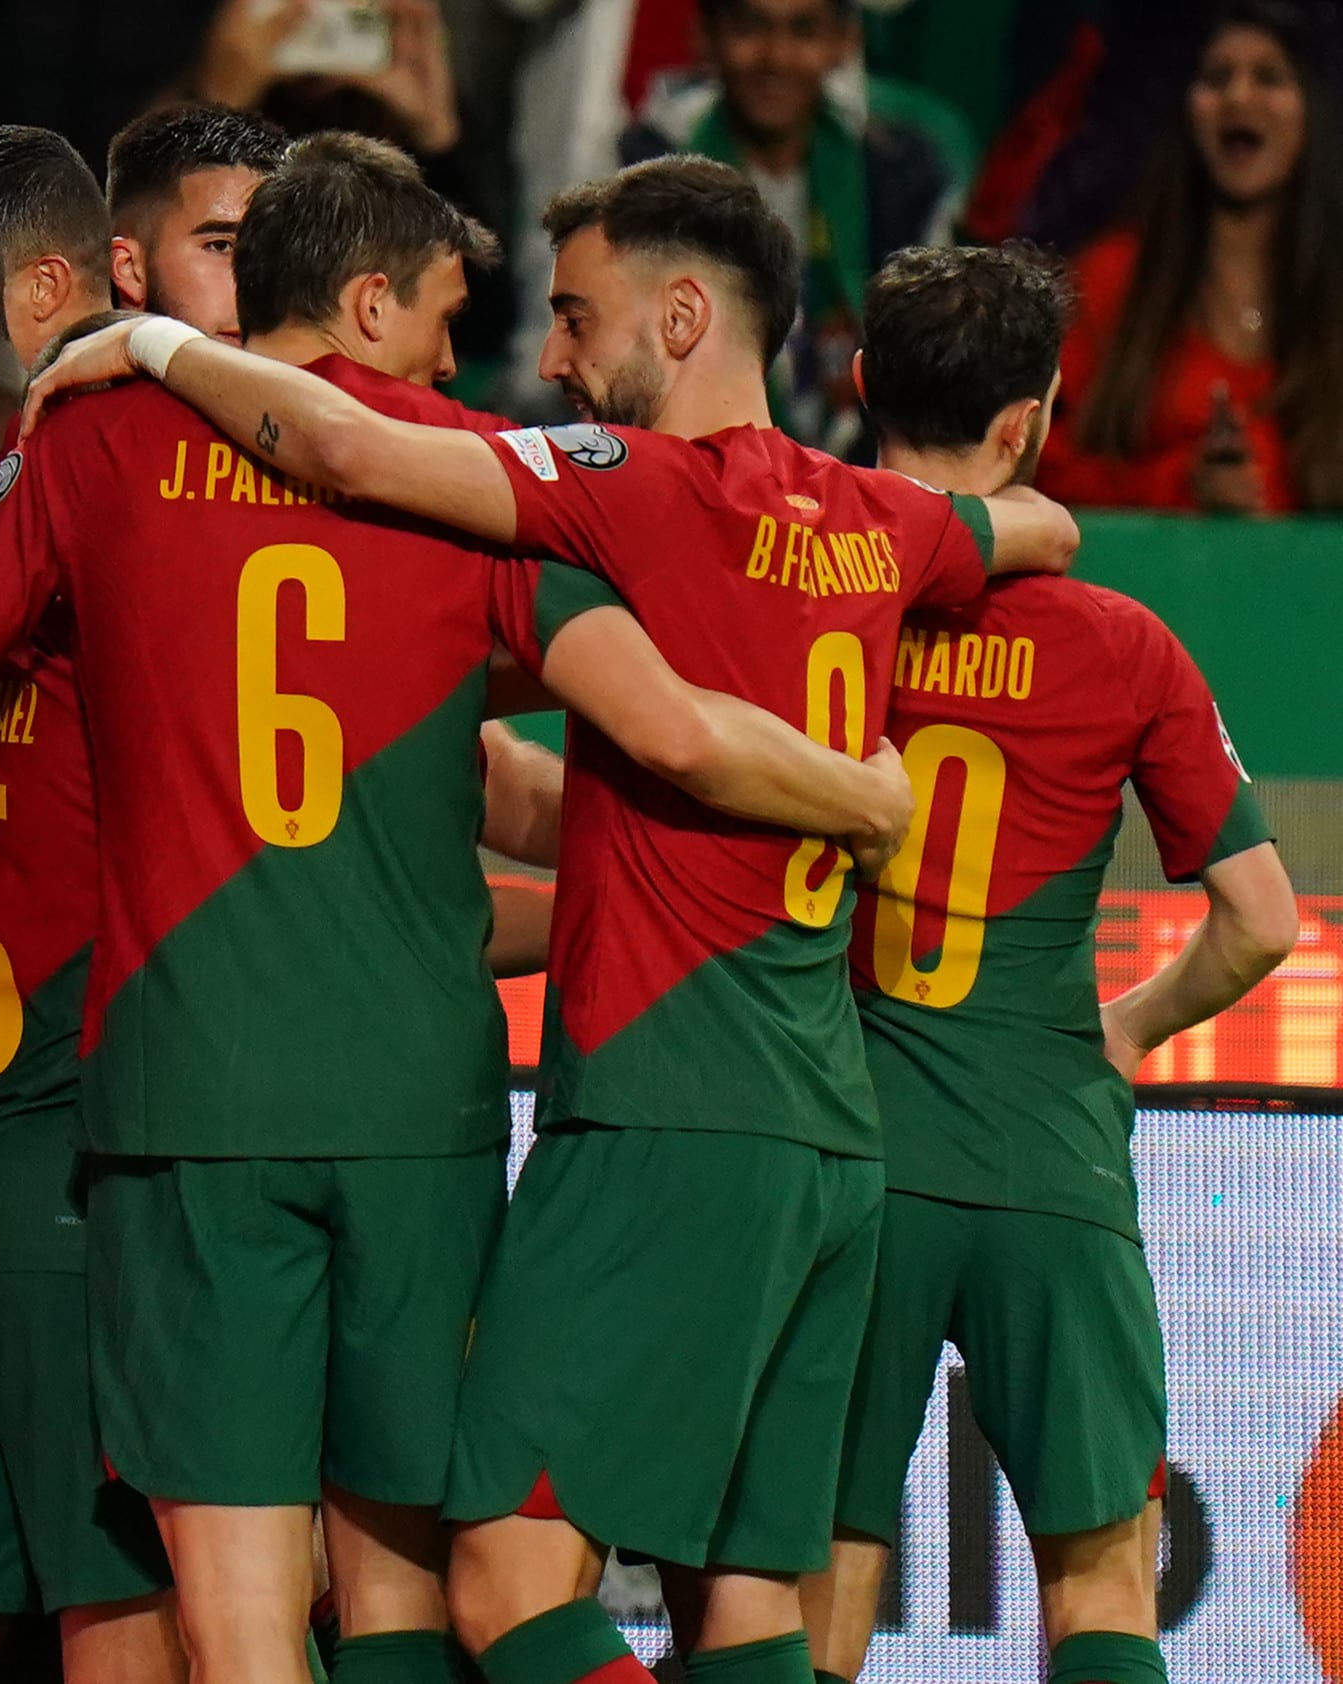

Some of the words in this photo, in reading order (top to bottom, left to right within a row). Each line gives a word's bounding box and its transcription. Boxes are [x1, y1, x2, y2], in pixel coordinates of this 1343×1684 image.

[745, 514, 901, 599] B.FEANDES
[236, 542, 347, 848] 6
[894, 627, 1036, 701] NARDO
[873, 723, 1007, 1009] 0
